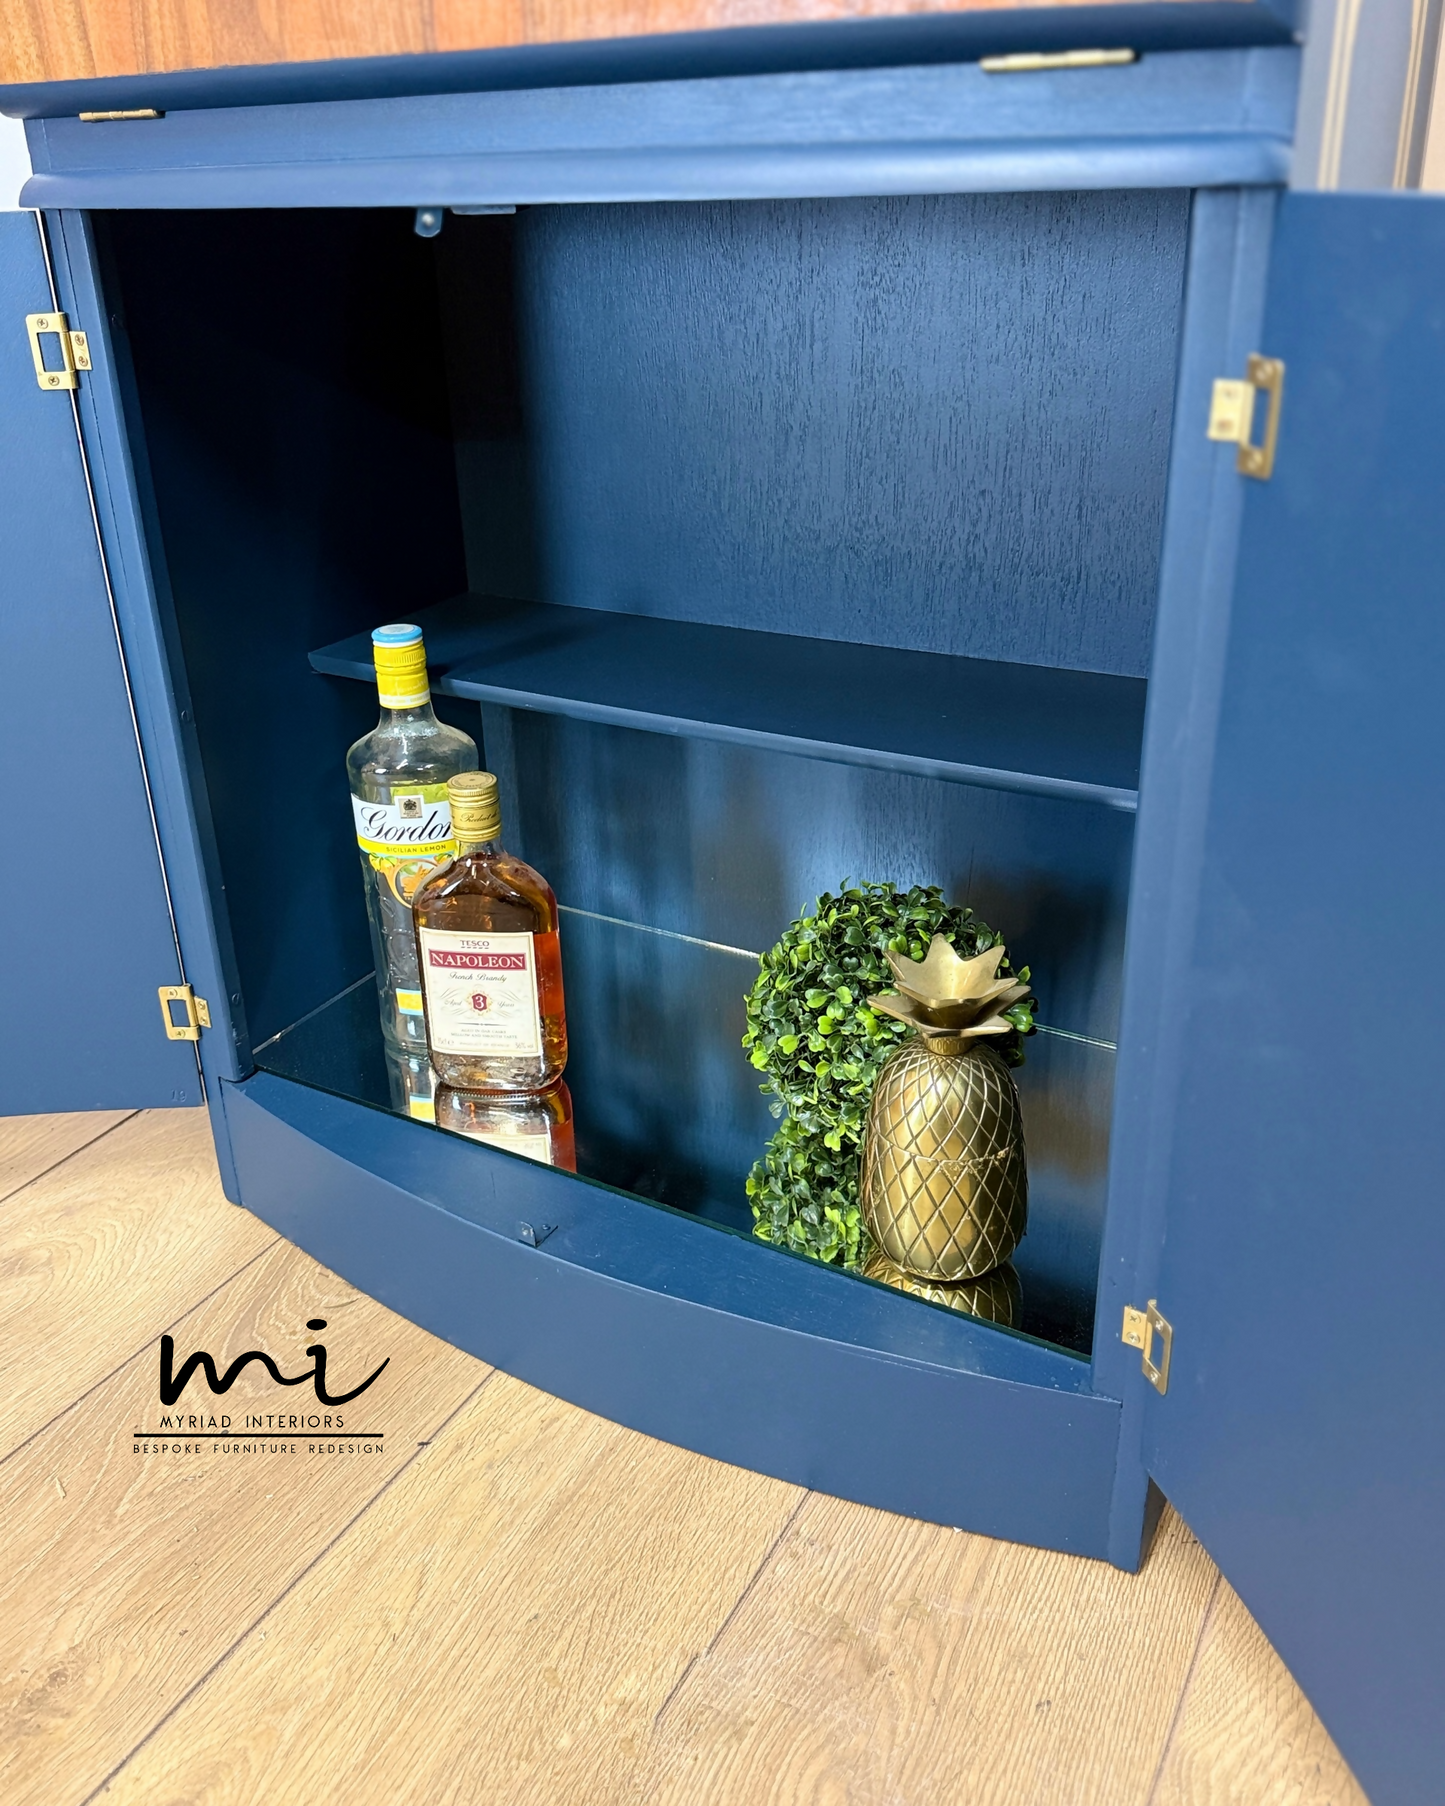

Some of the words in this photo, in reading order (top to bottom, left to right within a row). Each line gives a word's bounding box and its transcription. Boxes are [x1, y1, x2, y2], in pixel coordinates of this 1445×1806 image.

[420, 845, 446, 853] LEMON
[431, 952, 524, 968] NAPOLEON
[448, 971, 473, 981] French
[476, 973, 507, 983] Brandy
[475, 995, 485, 1009] 3
